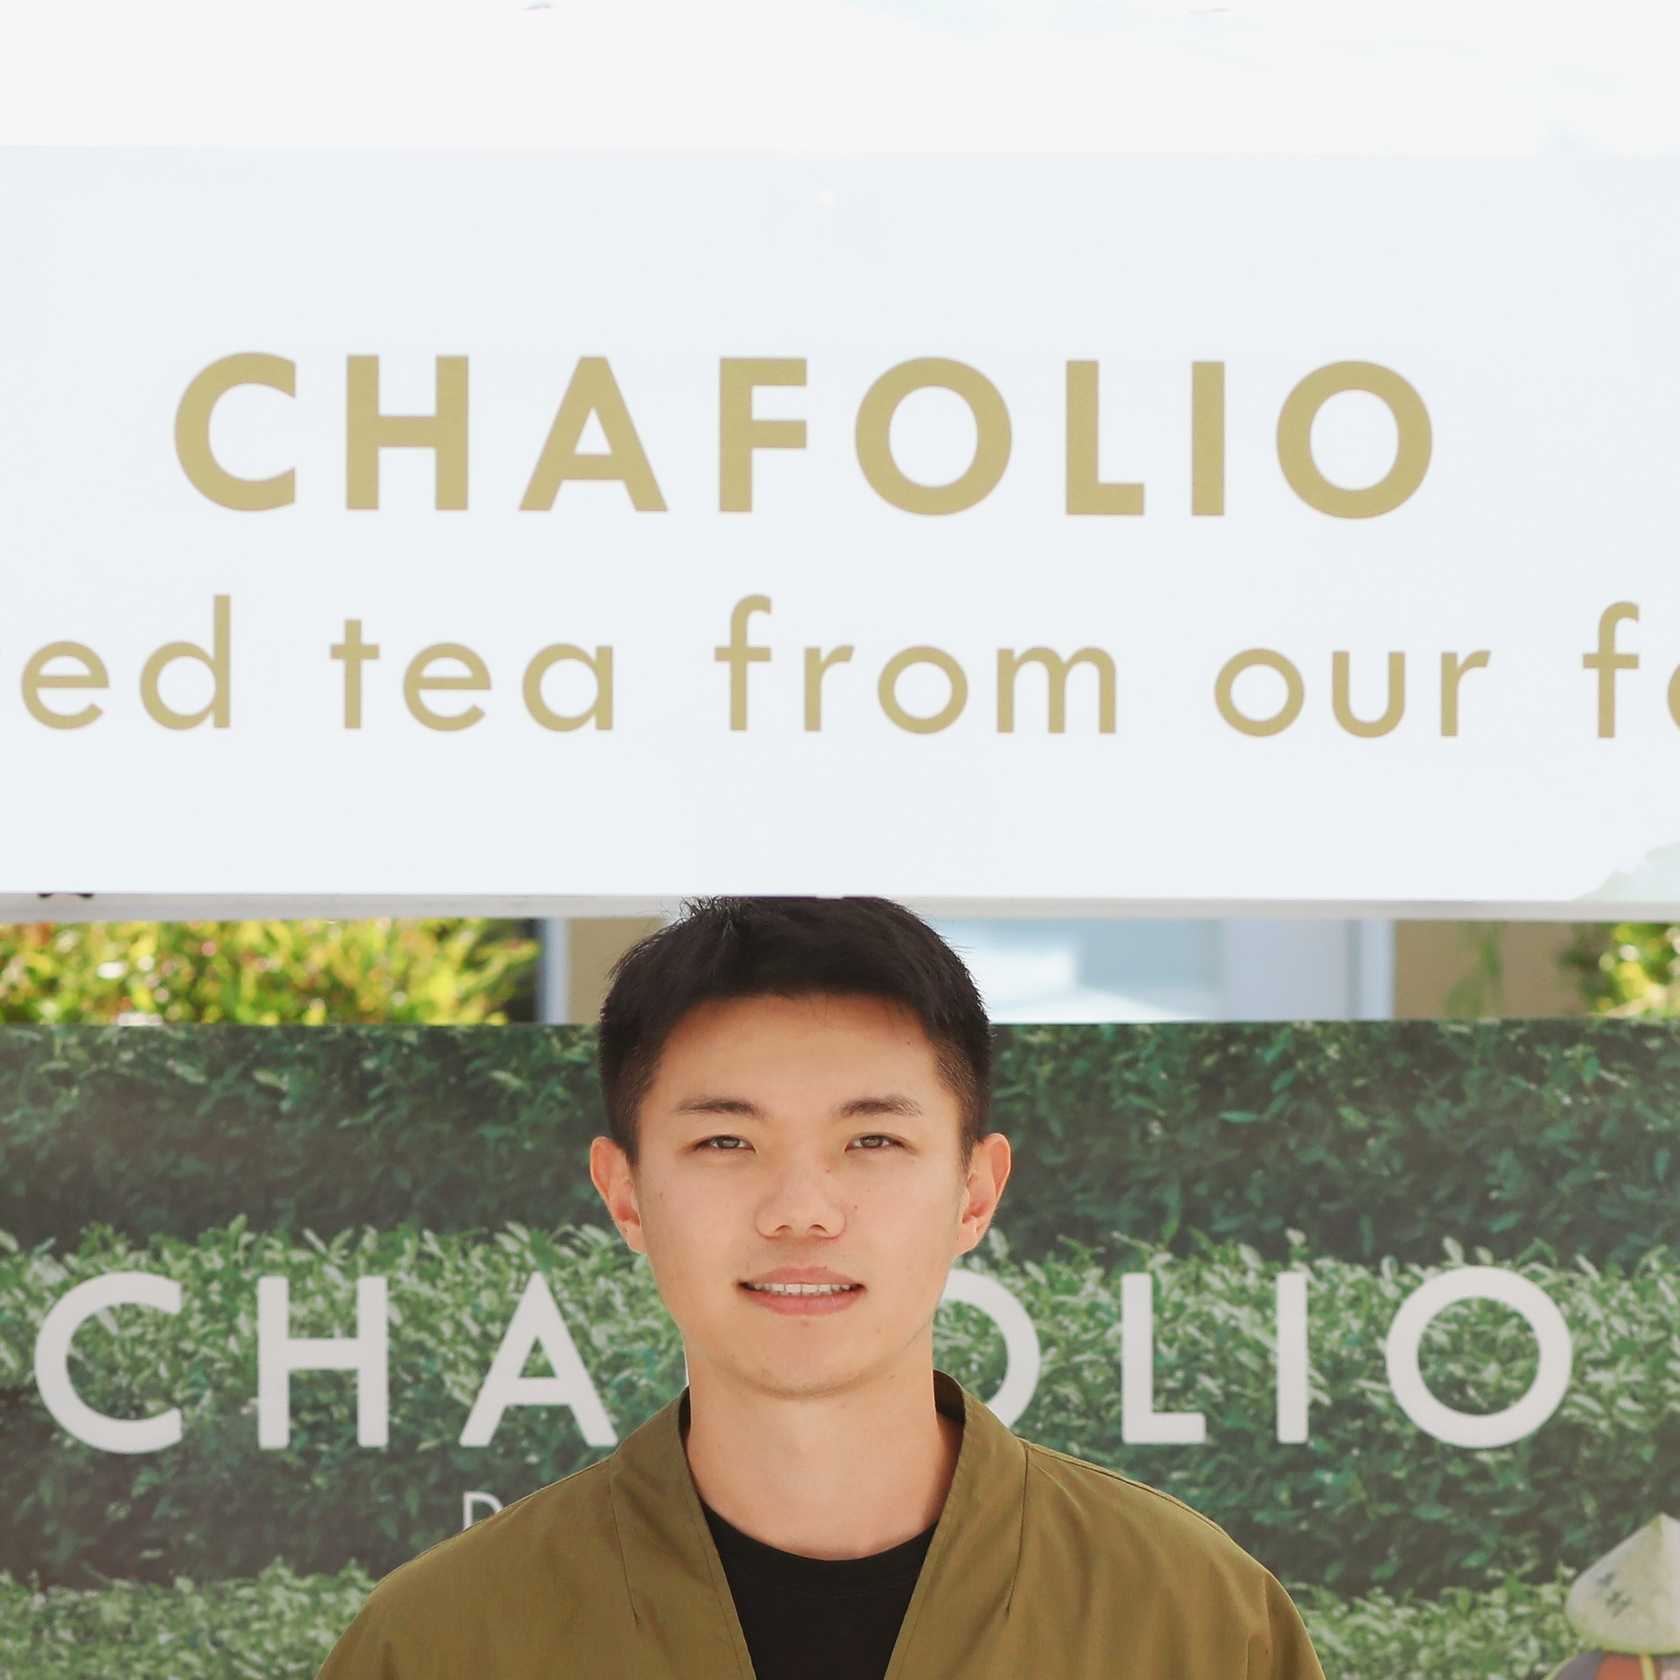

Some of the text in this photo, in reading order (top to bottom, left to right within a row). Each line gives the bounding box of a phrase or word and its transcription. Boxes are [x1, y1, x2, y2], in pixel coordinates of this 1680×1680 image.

[174, 351, 1433, 520] CHAFOLIO
[329, 618, 614, 733] tea
[713, 595, 1118, 736] from
[1213, 648, 1490, 738] our
[34, 1264, 1573, 1453] CHAOLIO
